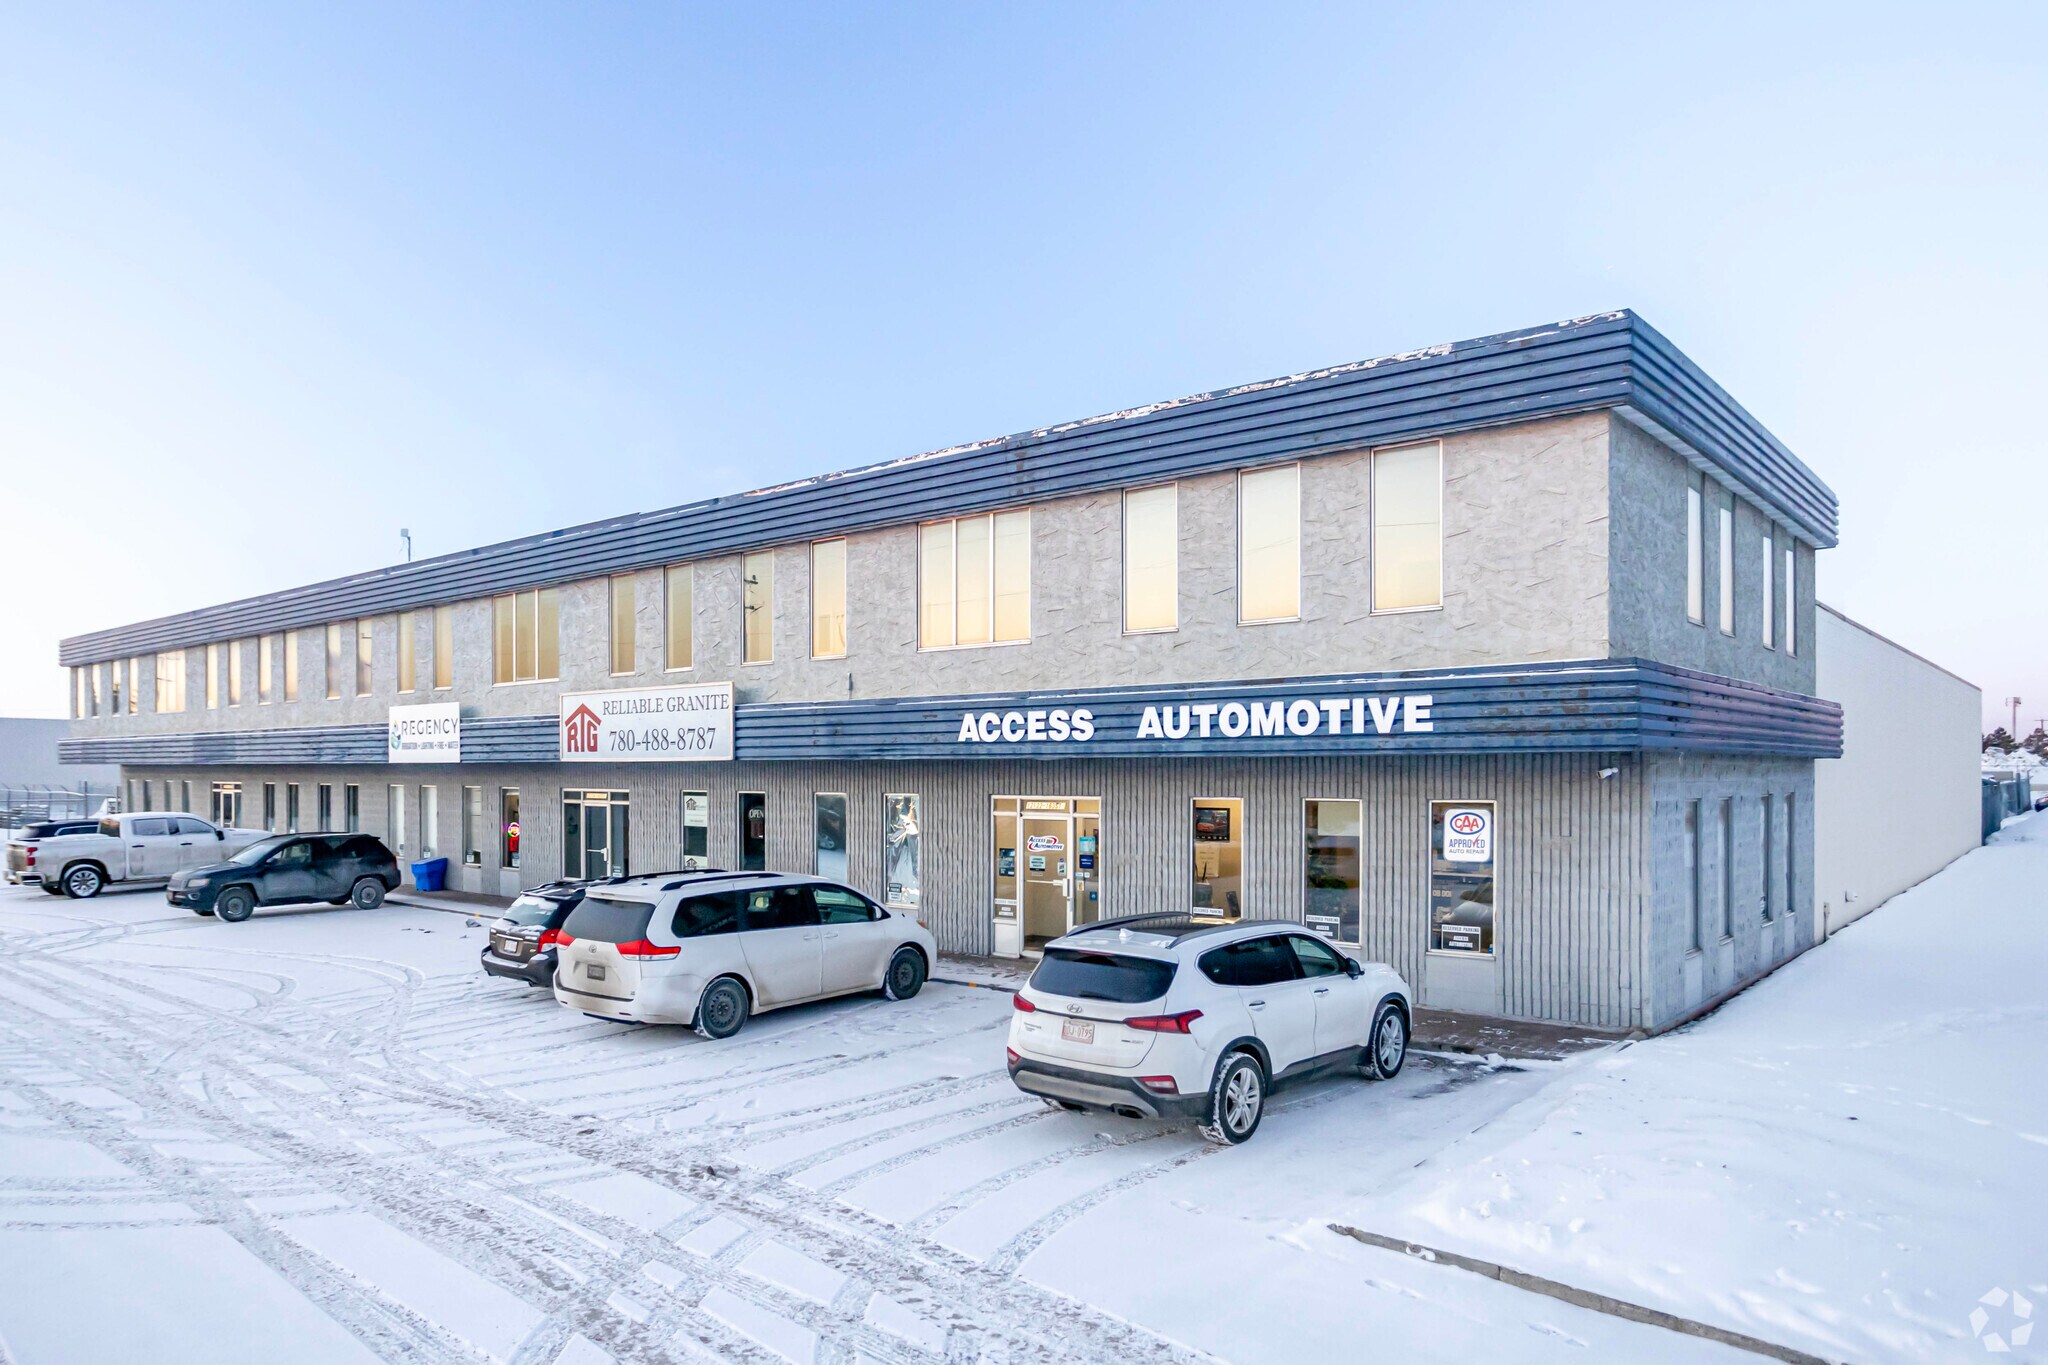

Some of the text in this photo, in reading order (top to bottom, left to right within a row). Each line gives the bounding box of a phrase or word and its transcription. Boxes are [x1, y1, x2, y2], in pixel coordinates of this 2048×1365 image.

[603, 693, 729, 716] RELIABLE GRANITE
[401, 718, 458, 736] REGENCY
[564, 703, 602, 752] RTG
[957, 694, 1434, 742] ACCESS AUTOMOTIVE
[609, 726, 716, 752] 780-488-8787
[748, 808, 764, 819] OPEN
[1454, 815, 1479, 832] CAA
[1448, 836, 1486, 849] APPROVED
